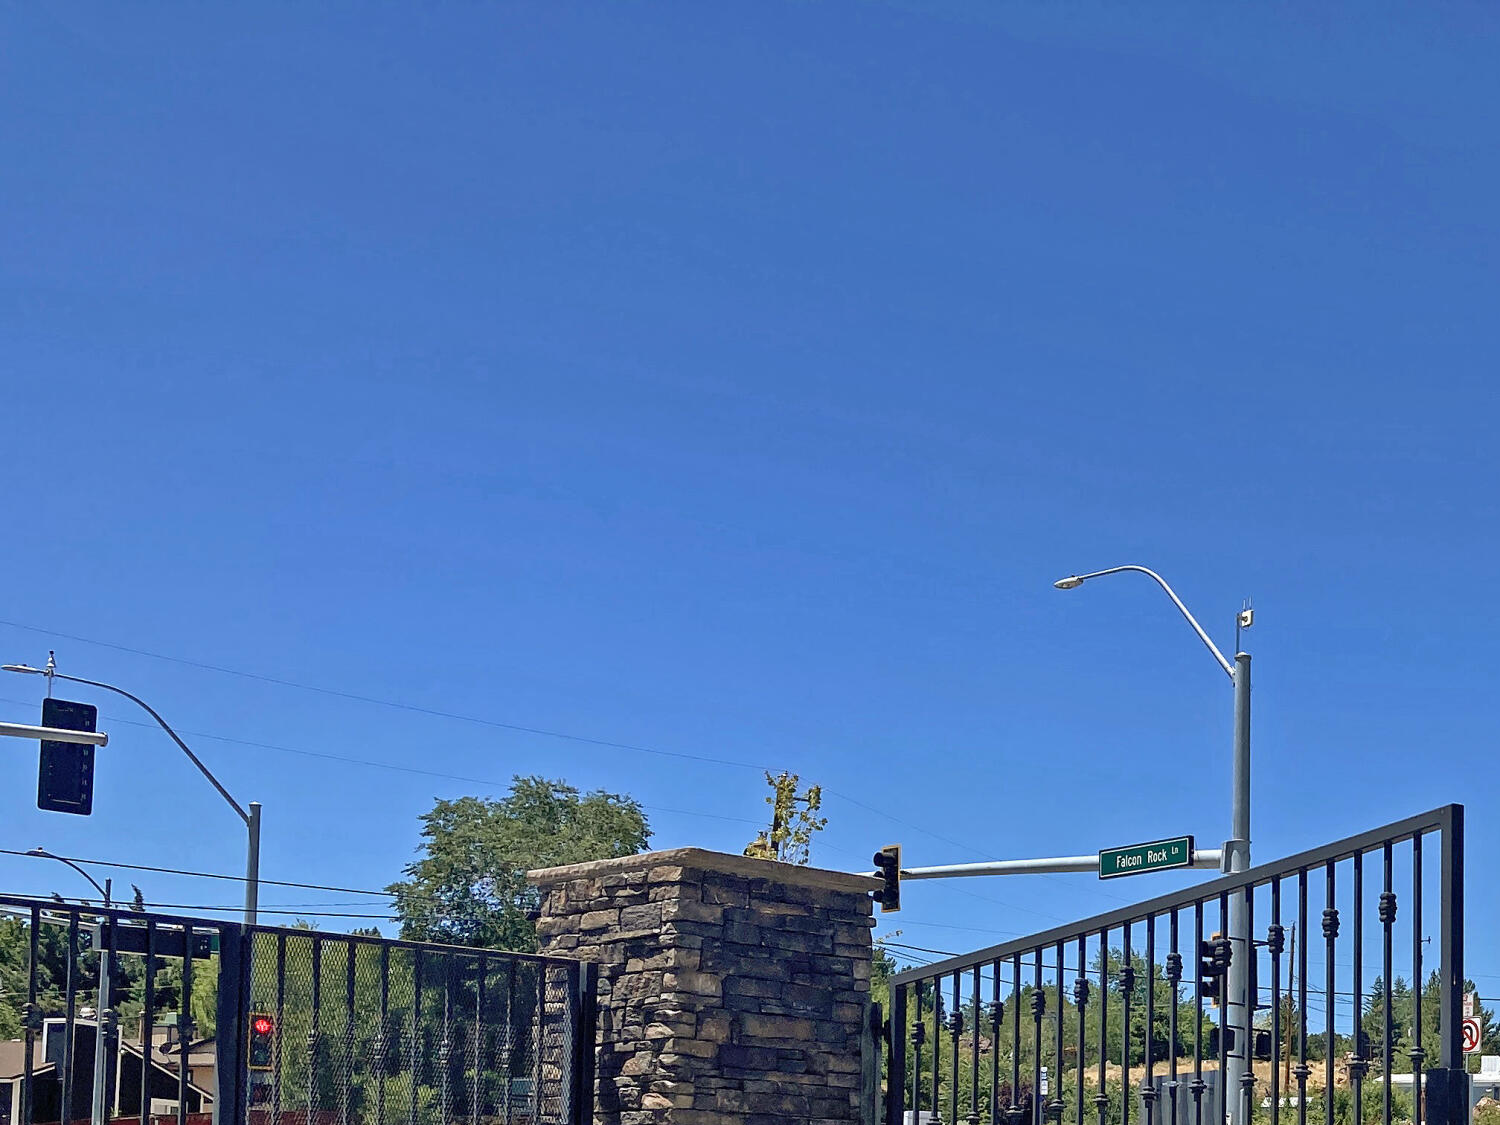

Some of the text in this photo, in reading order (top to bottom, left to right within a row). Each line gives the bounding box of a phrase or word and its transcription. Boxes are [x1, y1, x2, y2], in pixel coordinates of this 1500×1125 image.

[1116, 846, 1179, 869] Falcon Rock Ln
